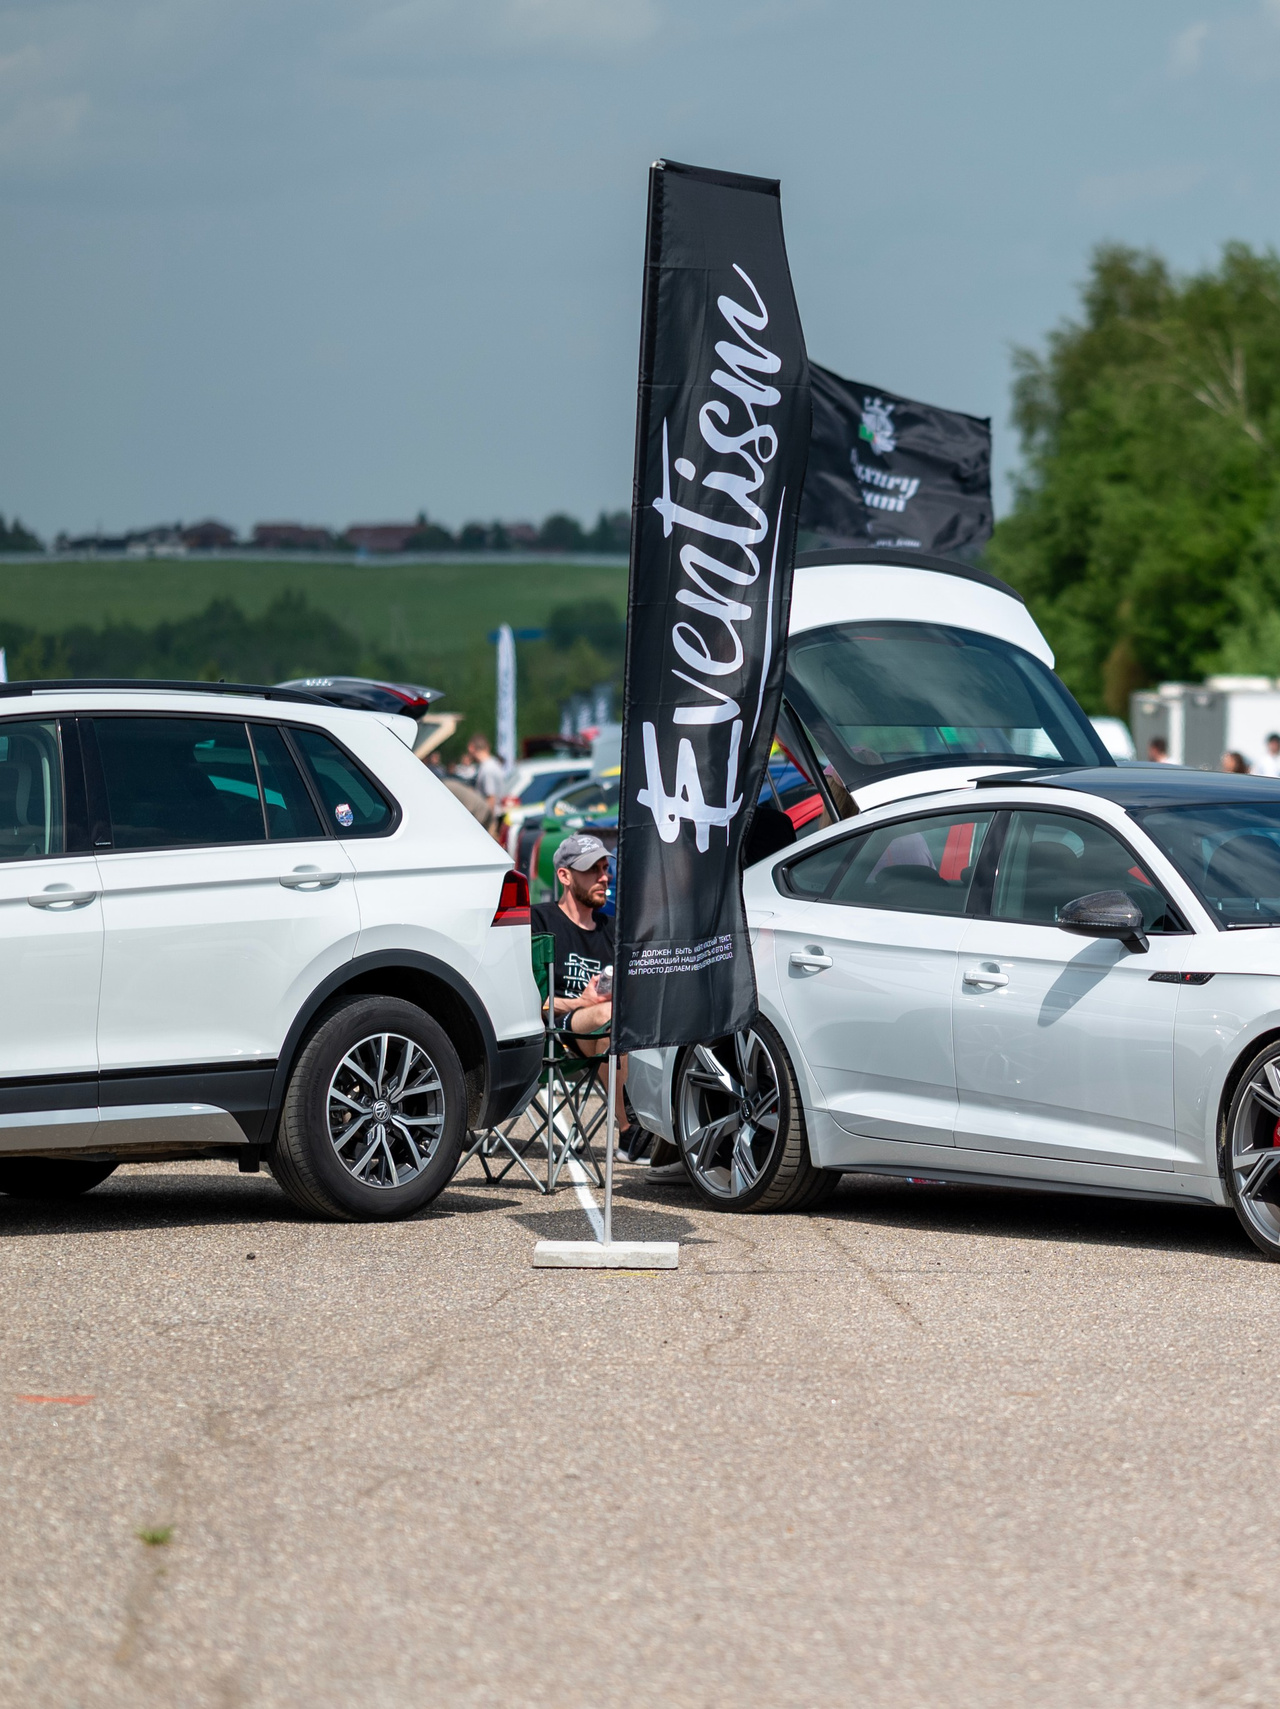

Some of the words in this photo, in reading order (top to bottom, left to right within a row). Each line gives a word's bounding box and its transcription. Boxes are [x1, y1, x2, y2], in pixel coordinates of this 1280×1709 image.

[637, 263, 782, 853] Eventism
[641, 949, 672, 958] ДОЛЖЕН
[675, 947, 692, 955] БЫТЬ
[628, 956, 680, 967] ОПИСЫВАЮЩИЙ
[638, 966, 664, 975] ПРОСТО
[664, 964, 691, 973] ДЕЛАЕМ
